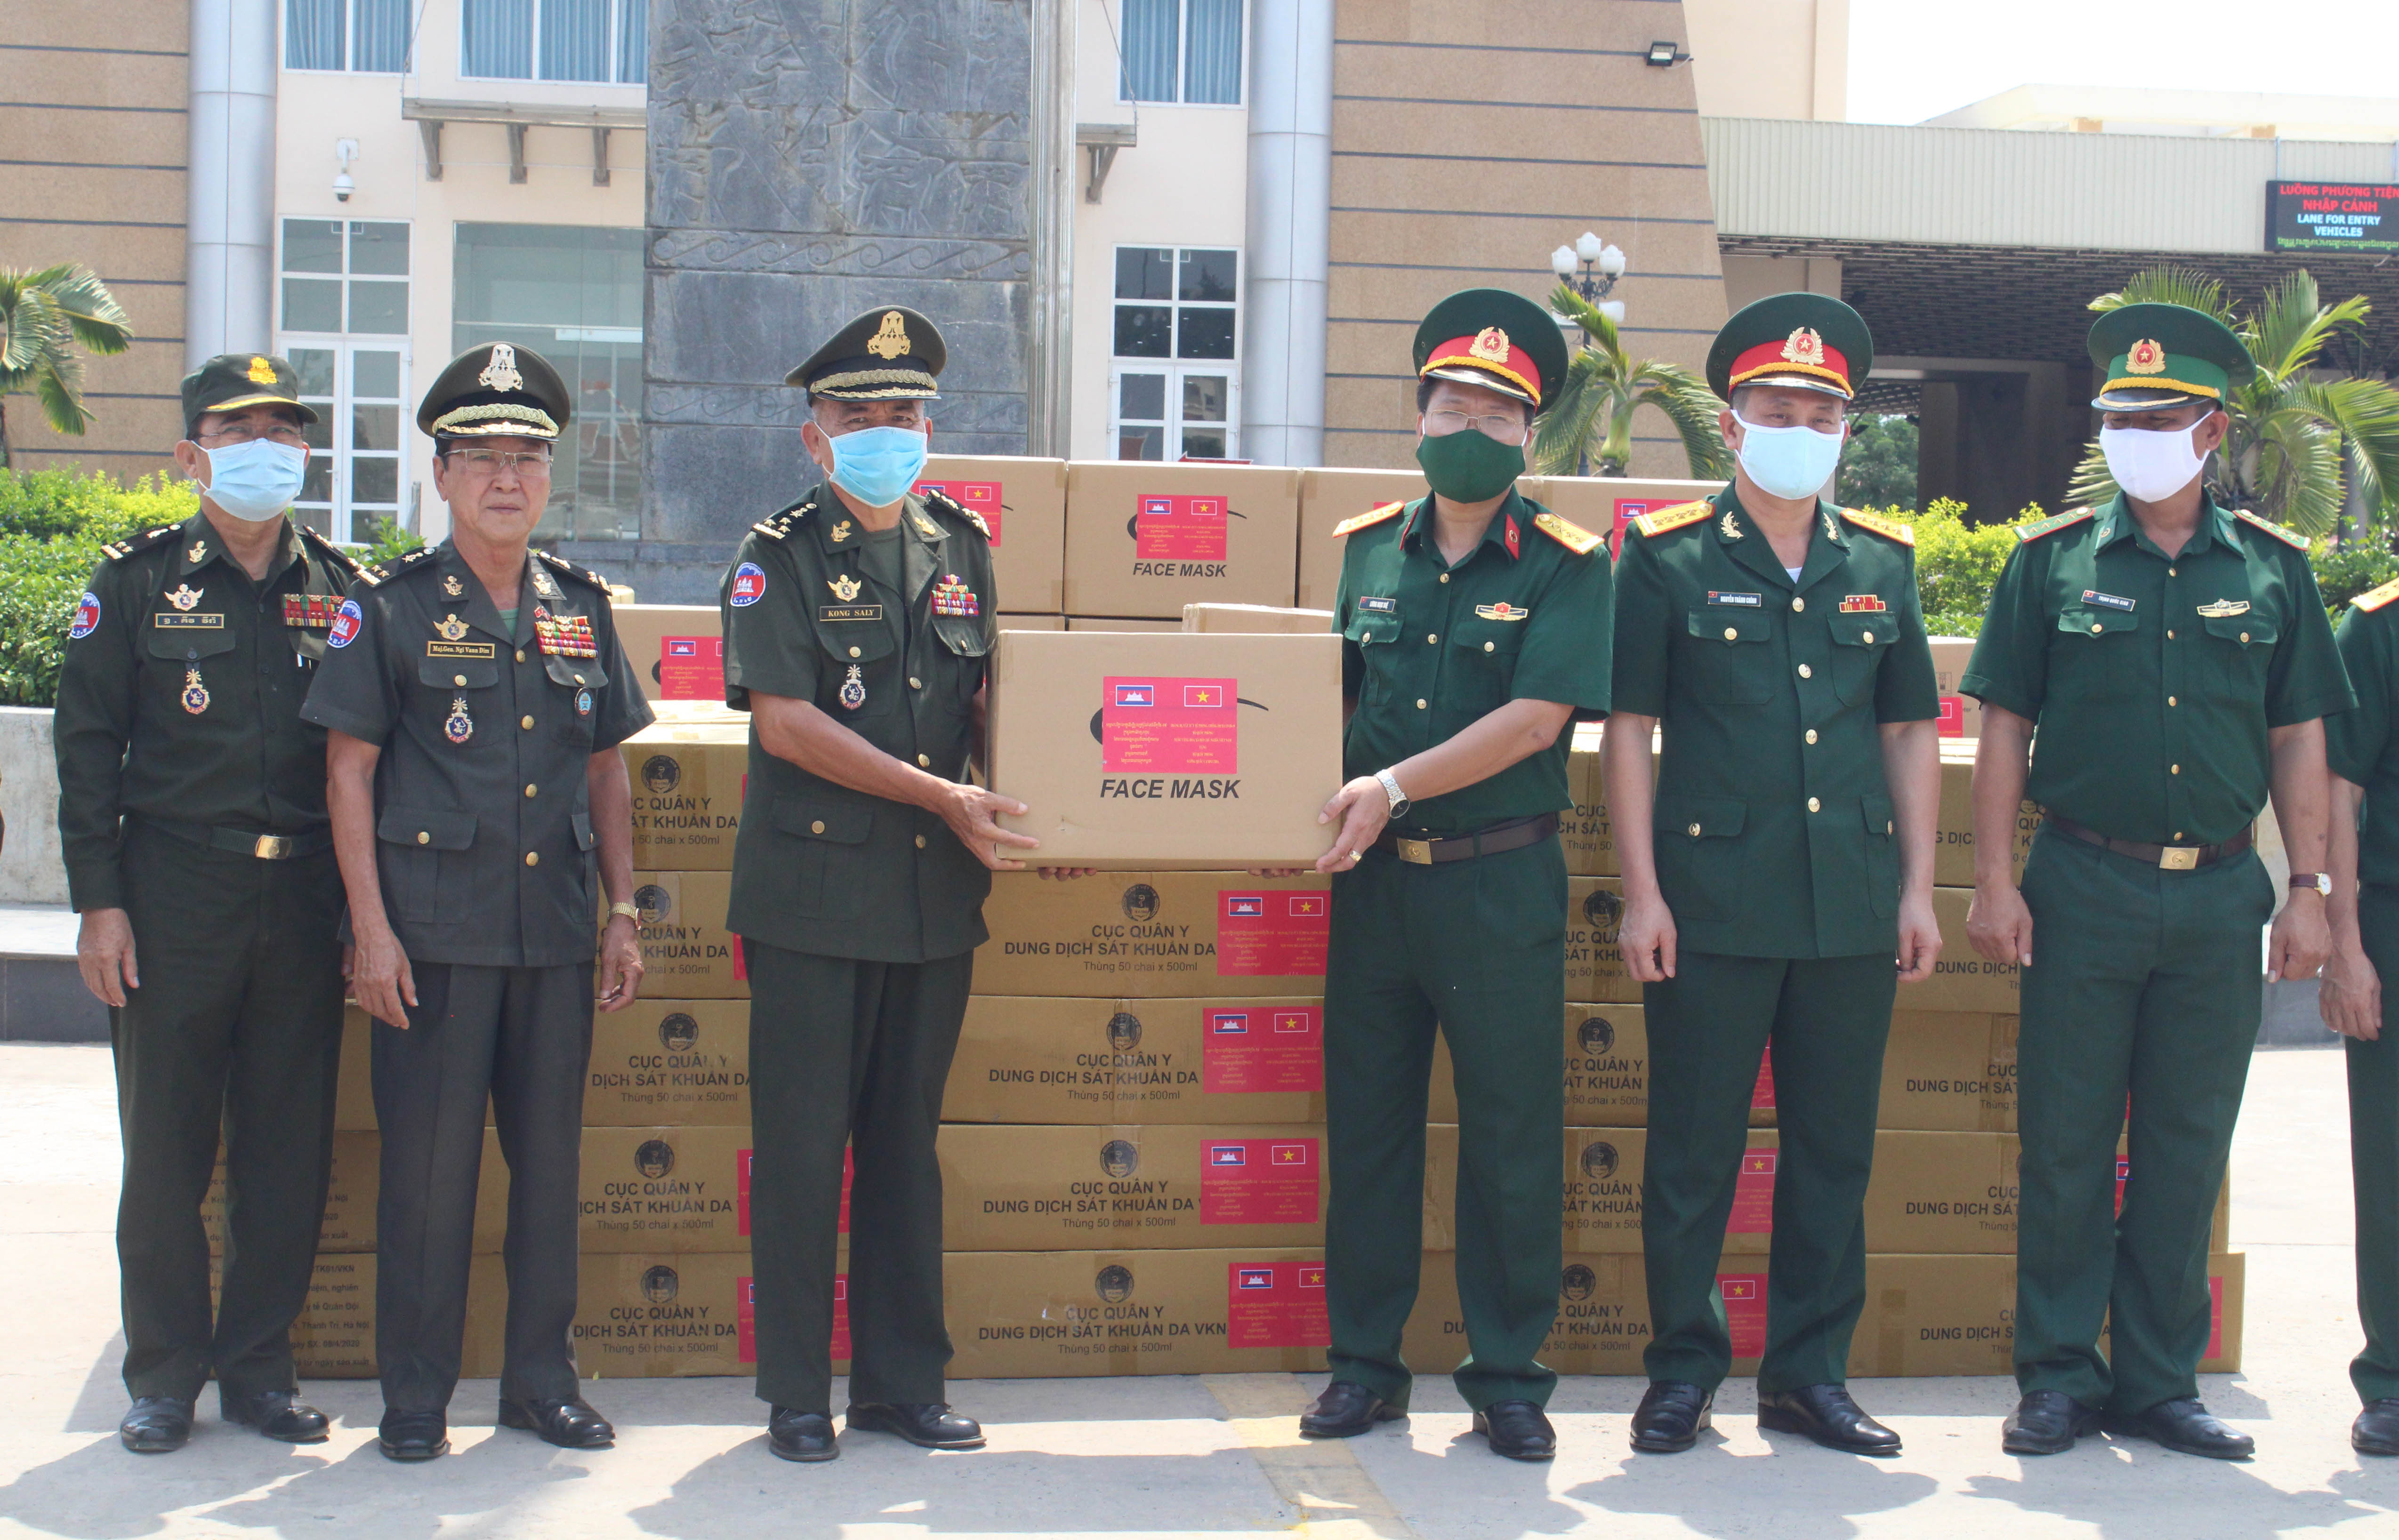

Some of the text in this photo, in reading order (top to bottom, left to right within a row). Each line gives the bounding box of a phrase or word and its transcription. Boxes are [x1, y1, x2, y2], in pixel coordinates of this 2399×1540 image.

[2303, 197, 2338, 213] NHẬP
[2297, 214, 2381, 225] LANE FOR ENTRY
[2314, 226, 2363, 237] VEHICLES
[1133, 563, 1227, 578] FACE MASK
[1100, 779, 1241, 799] FACE MASK
[650, 794, 695, 810] QUÂN
[701, 798, 711, 810] Y
[1576, 805, 1606, 819] CỤC
[716, 816, 738, 828] DA
[1582, 819, 1610, 834] SÁT
[639, 835, 651, 844] 50
[655, 835, 675, 844] chai
[689, 835, 719, 844] 500ml
[1567, 840, 1611, 852] Thùng 50
[640, 924, 701, 940] QUÂN Y
[1092, 922, 1190, 940] CỤC QUÂN Y
[707, 946, 729, 958] DA
[1005, 942, 1050, 955] DUNG
[1055, 943, 1093, 958] DỊCH
[1098, 939, 1129, 955] SÁT
[1194, 943, 1216, 955] DA
[679, 965, 709, 974] 500ml
[1084, 961, 1198, 973] Thùng 50 chai 500ml
[1580, 967, 1591, 976] 50
[1594, 967, 1614, 976] chai
[1936, 962, 2017, 977] DUNG DỊCH
[629, 1055, 662, 1070] CỤC
[1077, 1051, 1172, 1069] CỤC QUÂN Y
[1585, 1056, 1628, 1072] QUÂN
[1634, 1060, 1642, 1071] Y
[989, 1069, 1035, 1083] DUNG
[1040, 1071, 1077, 1086] DỊCH
[1082, 1067, 1113, 1084] SÁT
[1177, 1071, 1199, 1083] DA
[1988, 1064, 2017, 1079] CỤC
[592, 1074, 629, 1089] DỊCH
[636, 1070, 667, 1085] SÁT
[1907, 1080, 1988, 1096] DUNG DỊCH
[621, 1092, 738, 1104] Thùng 50 chai 500ml
[1068, 1090, 1180, 1102] Thùng 50 chai 500ml
[1574, 1095, 1585, 1104] 50
[1588, 1095, 1608, 1105] chai
[1980, 1099, 2009, 1111] Thùng
[604, 1180, 705, 1200] CỤC QUÂN Y
[1071, 1178, 1168, 1197] CỤC QUÂN Y
[1589, 1180, 1632, 1195] QUÂN
[1988, 1186, 2019, 1201] CỤC
[612, 1198, 643, 1213] SÁT
[710, 1200, 733, 1212] DA
[983, 1200, 1029, 1213] DUNG
[1035, 1200, 1072, 1216] DỊCH
[1077, 1196, 1108, 1211] SÁT
[1172, 1198, 1194, 1211] DA
[1907, 1202, 1948, 1214] DUNG
[1954, 1203, 1988, 1217] DỊCH
[597, 1219, 714, 1232] Thùng 50 chai 500ml
[1063, 1217, 1176, 1230] Thùng 50 chai 500ml
[1578, 1219, 1589, 1228] 50
[1592, 1219, 1611, 1228] chai
[610, 1306, 709, 1324] CỤC QUÂN Y
[1066, 1304, 1164, 1322] CỤC QUÂN Y
[1566, 1303, 1623, 1317] QUÂN Y
[574, 1322, 736, 1341] DỊCH SÁT DA
[979, 1326, 1025, 1340] DUNG
[1030, 1326, 1067, 1342] DỊCH
[1072, 1322, 1103, 1338] SÁT
[1168, 1323, 1189, 1336] DA
[1628, 1323, 1648, 1335] DA
[1921, 1327, 1961, 1340] DUNG
[1967, 1327, 2000, 1341] DỊCH
[603, 1343, 718, 1355] Thùng 50 chai 500ml
[1058, 1342, 1172, 1355] Thùng 50 chai 500ml
[1554, 1341, 1566, 1350] 50
[1569, 1341, 1588, 1350] chai
[1601, 1341, 1630, 1351] 500ml
